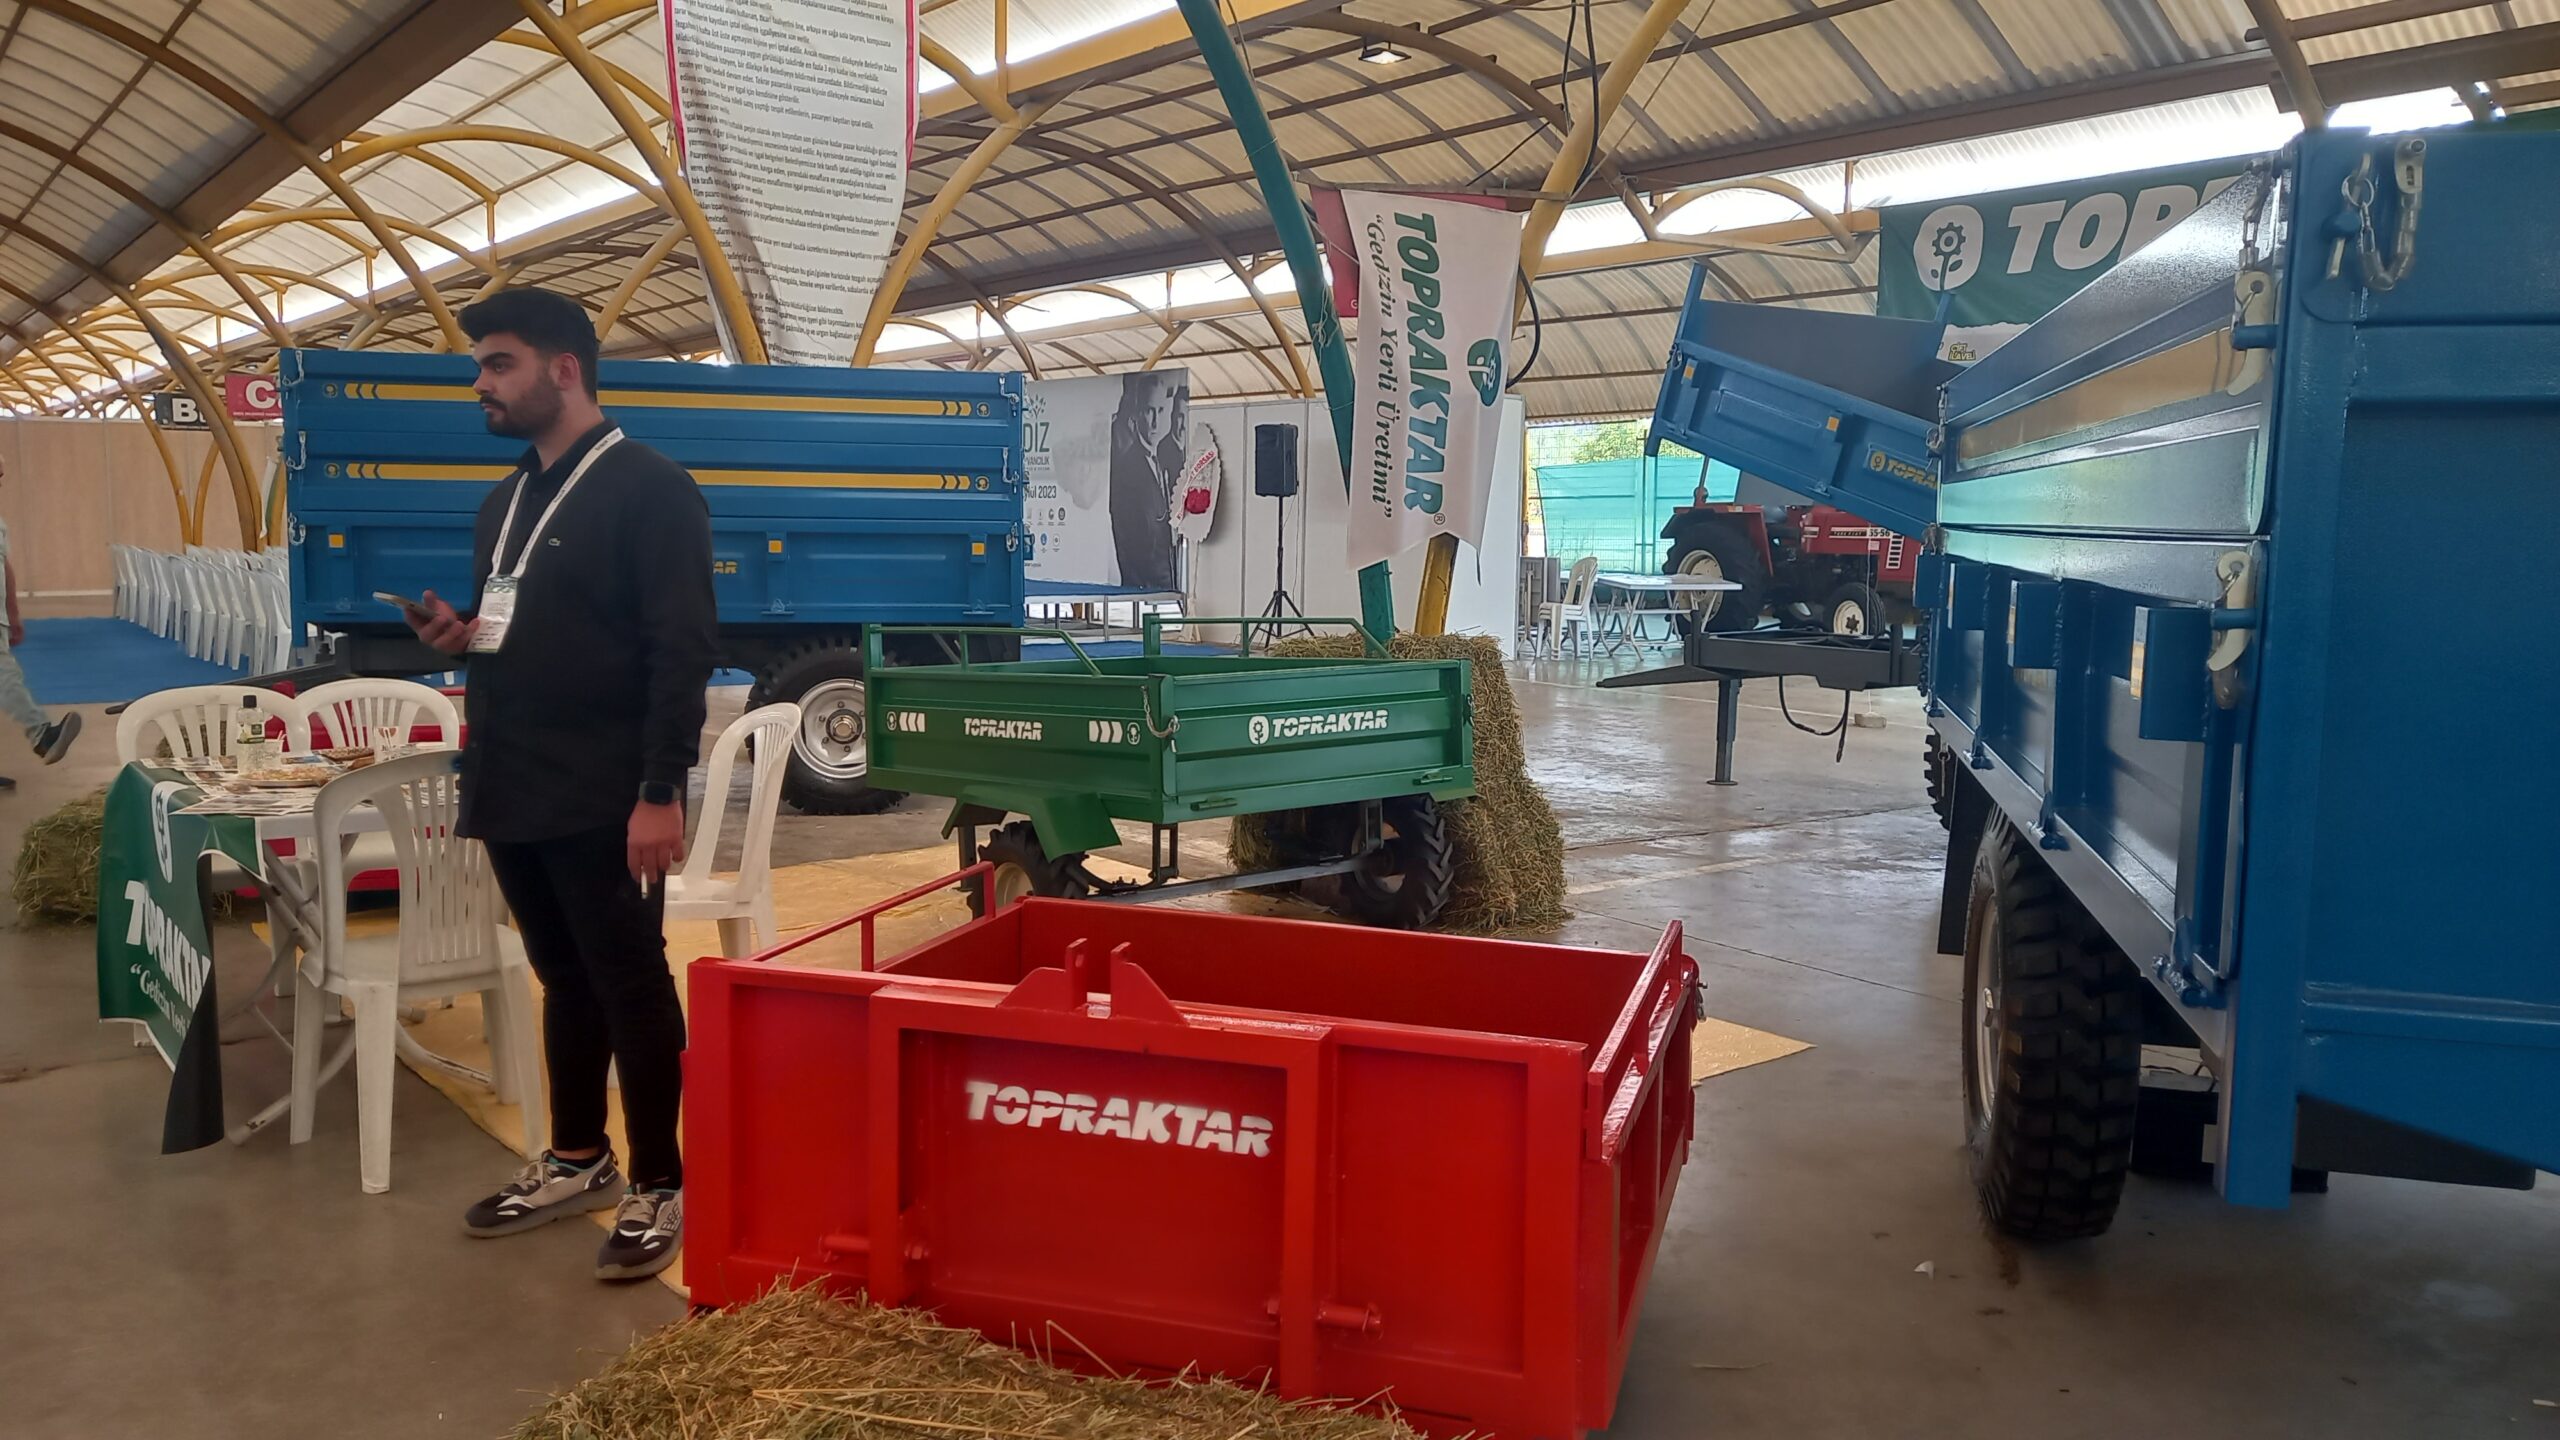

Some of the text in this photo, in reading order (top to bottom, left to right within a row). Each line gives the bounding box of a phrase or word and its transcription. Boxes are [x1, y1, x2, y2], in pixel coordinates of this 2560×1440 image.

[2007, 175, 2242, 274] TOP
[1376, 327, 1399, 392] Yerli
[1394, 212, 1451, 515] TOPRAKTAR
[1038, 485, 1056, 499] 2023
[964, 717, 1043, 741] TOPRAKTAR
[1272, 709, 1389, 738] TOPRAKTAR
[965, 1081, 1274, 1158] TOPRAKTAR
